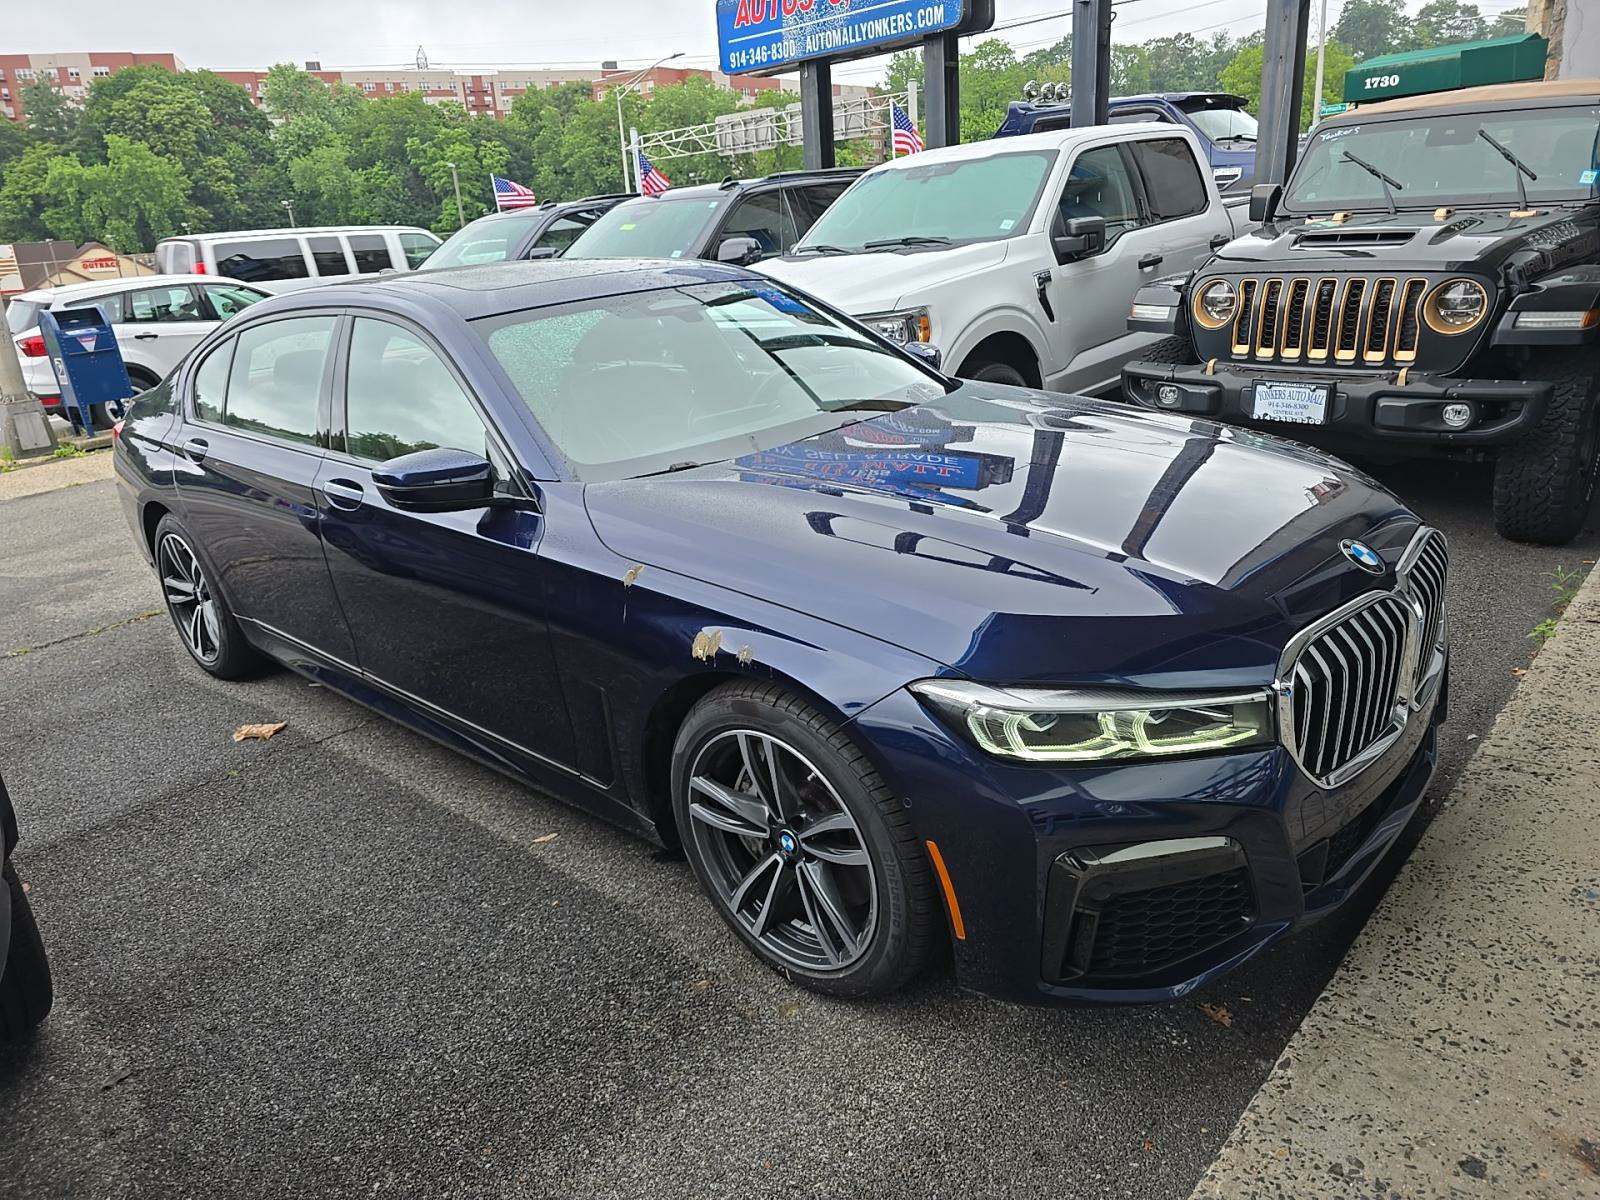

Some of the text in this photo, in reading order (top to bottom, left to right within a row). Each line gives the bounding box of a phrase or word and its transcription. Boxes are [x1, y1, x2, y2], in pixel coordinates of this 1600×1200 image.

[729, 4, 944, 69] 914-346-8300 AUTOMALLYONKERS.COM
[1364, 74, 1400, 90] 1730
[1258, 389, 1286, 401] YONKERS
[1286, 390, 1306, 402] AUTO
